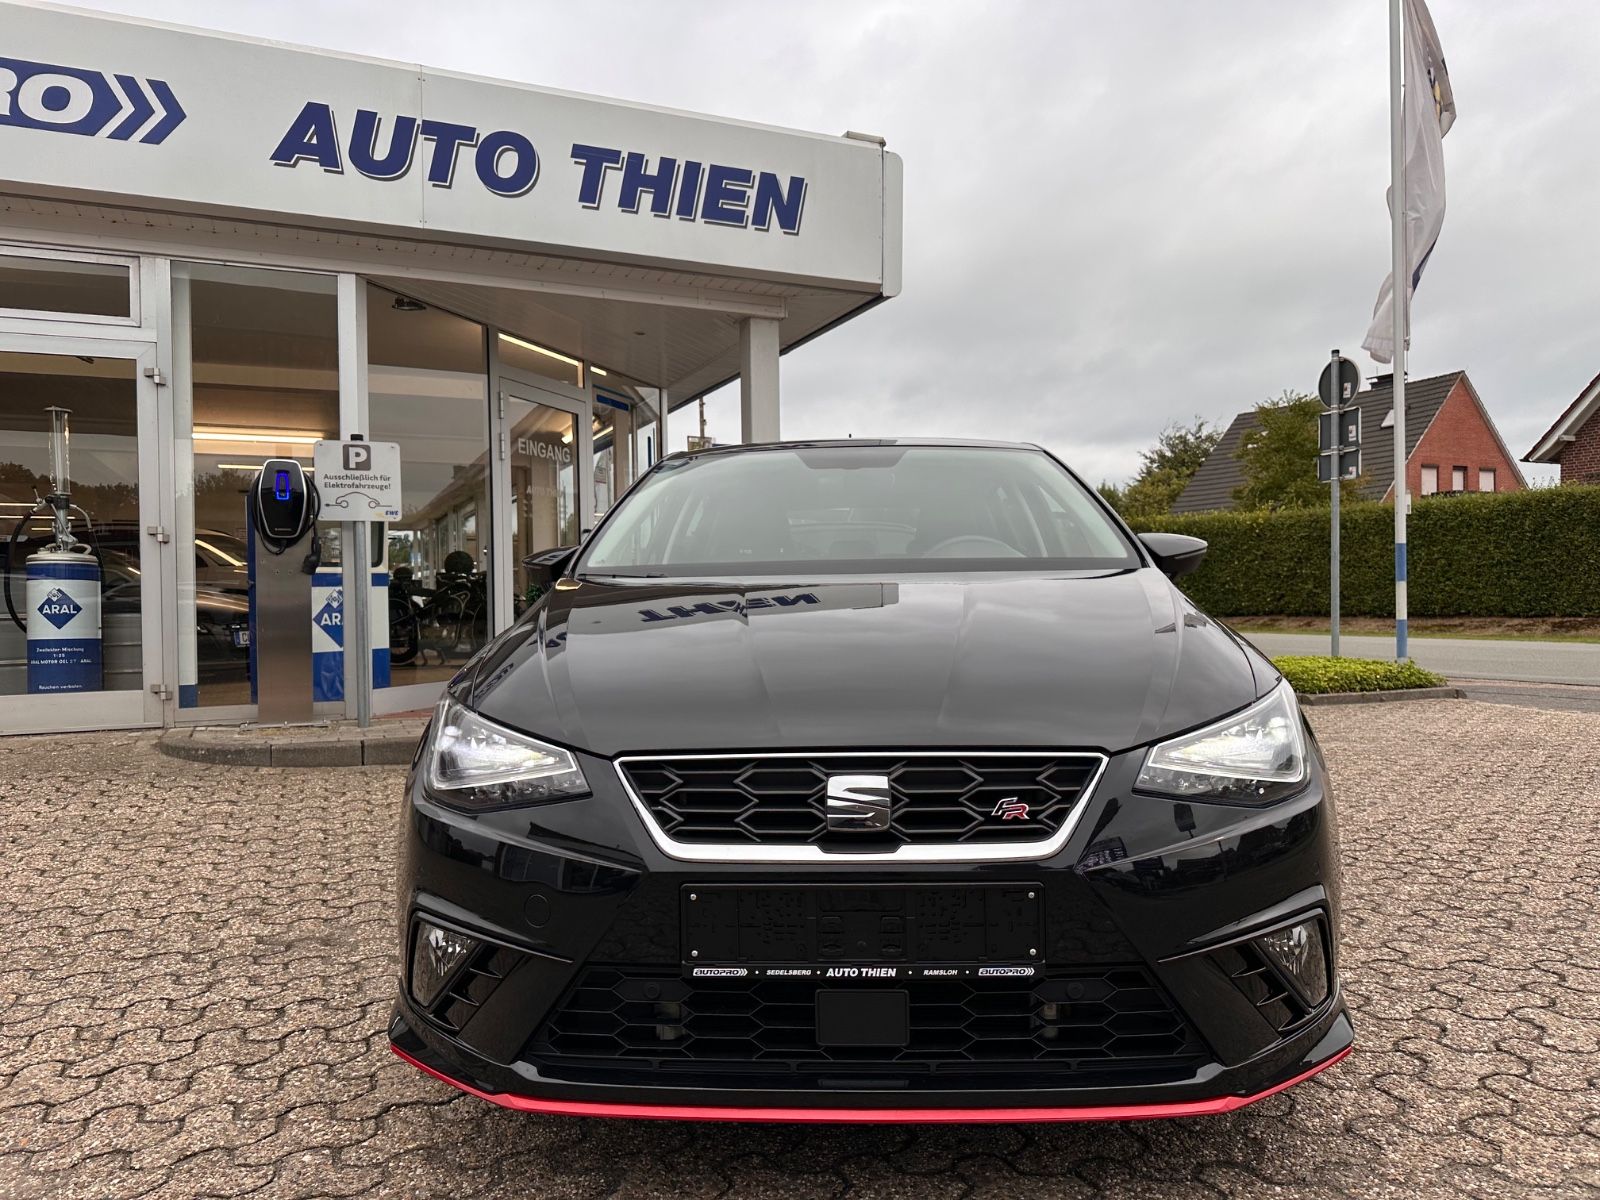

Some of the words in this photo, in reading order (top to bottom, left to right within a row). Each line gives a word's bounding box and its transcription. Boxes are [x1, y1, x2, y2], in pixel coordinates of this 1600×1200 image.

[269, 101, 540, 198] AUTO
[570, 143, 808, 236] THIEN
[518, 437, 571, 463] EINGANG
[348, 446, 368, 469] P
[323, 473, 378, 482] Ausschließlich
[324, 481, 391, 491] Elektrofahrzeuge!
[42, 604, 77, 615] ARAL
[826, 968, 859, 977] AUTO
[861, 968, 896, 977] THIEN
